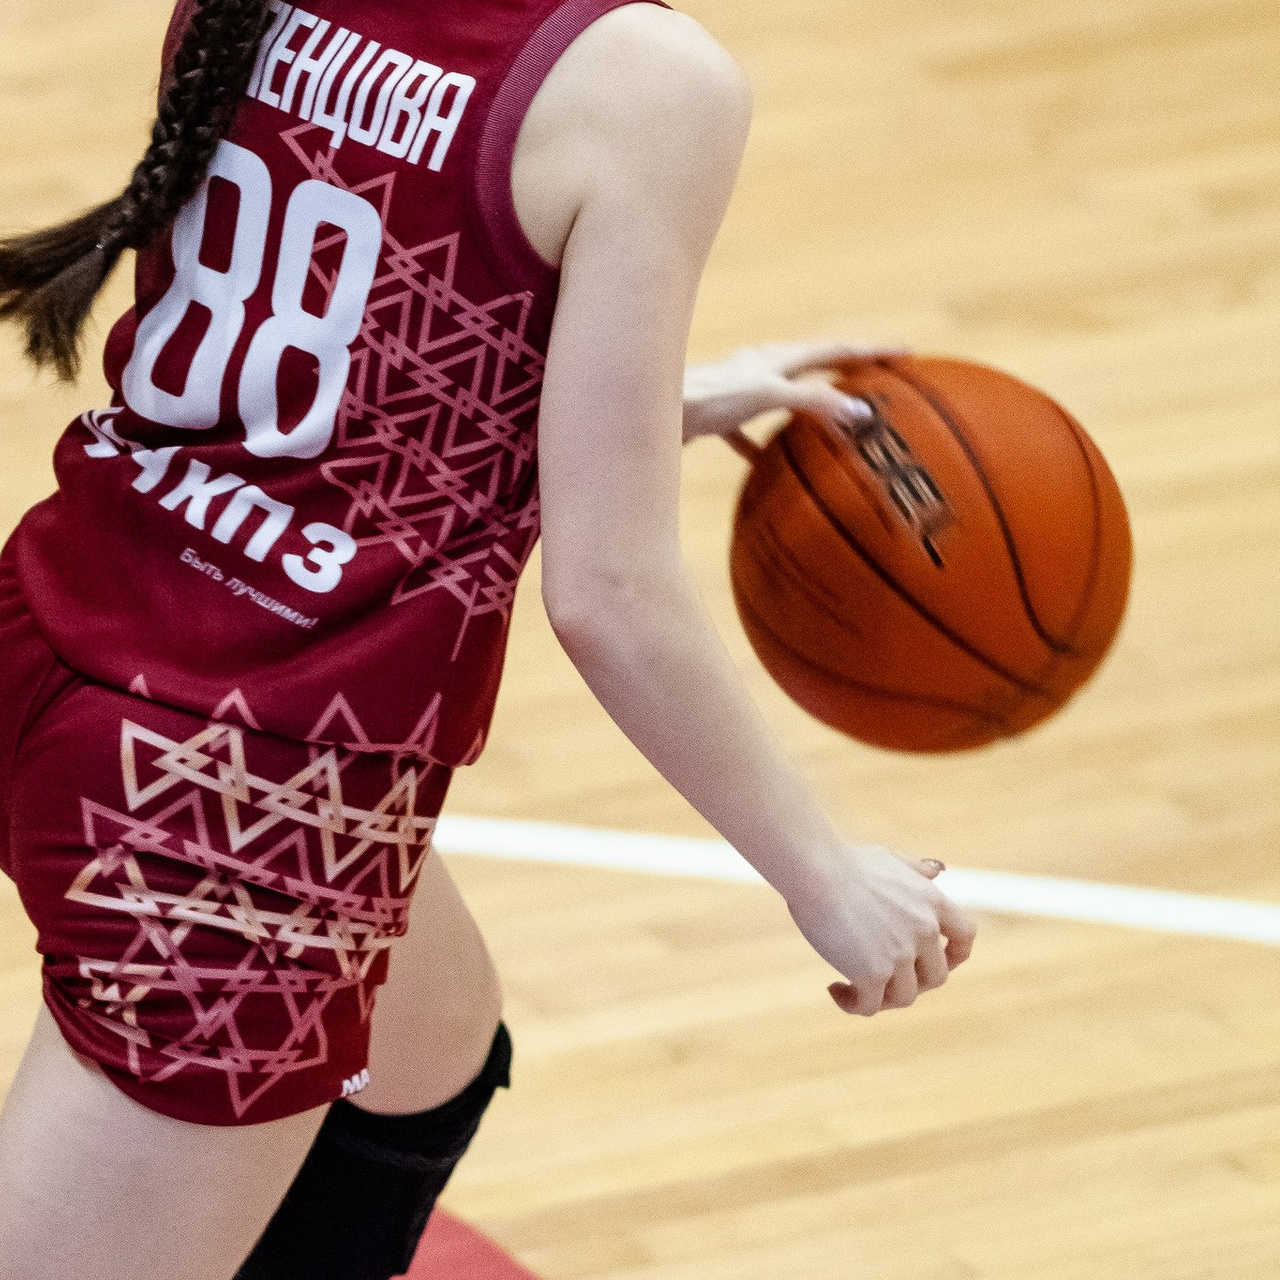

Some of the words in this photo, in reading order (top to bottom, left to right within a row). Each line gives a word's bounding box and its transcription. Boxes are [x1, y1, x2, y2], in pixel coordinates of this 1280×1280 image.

[122, 138, 382, 458] 88
[179, 547, 224, 581] Быть
[225, 577, 319, 628] лучшими!
